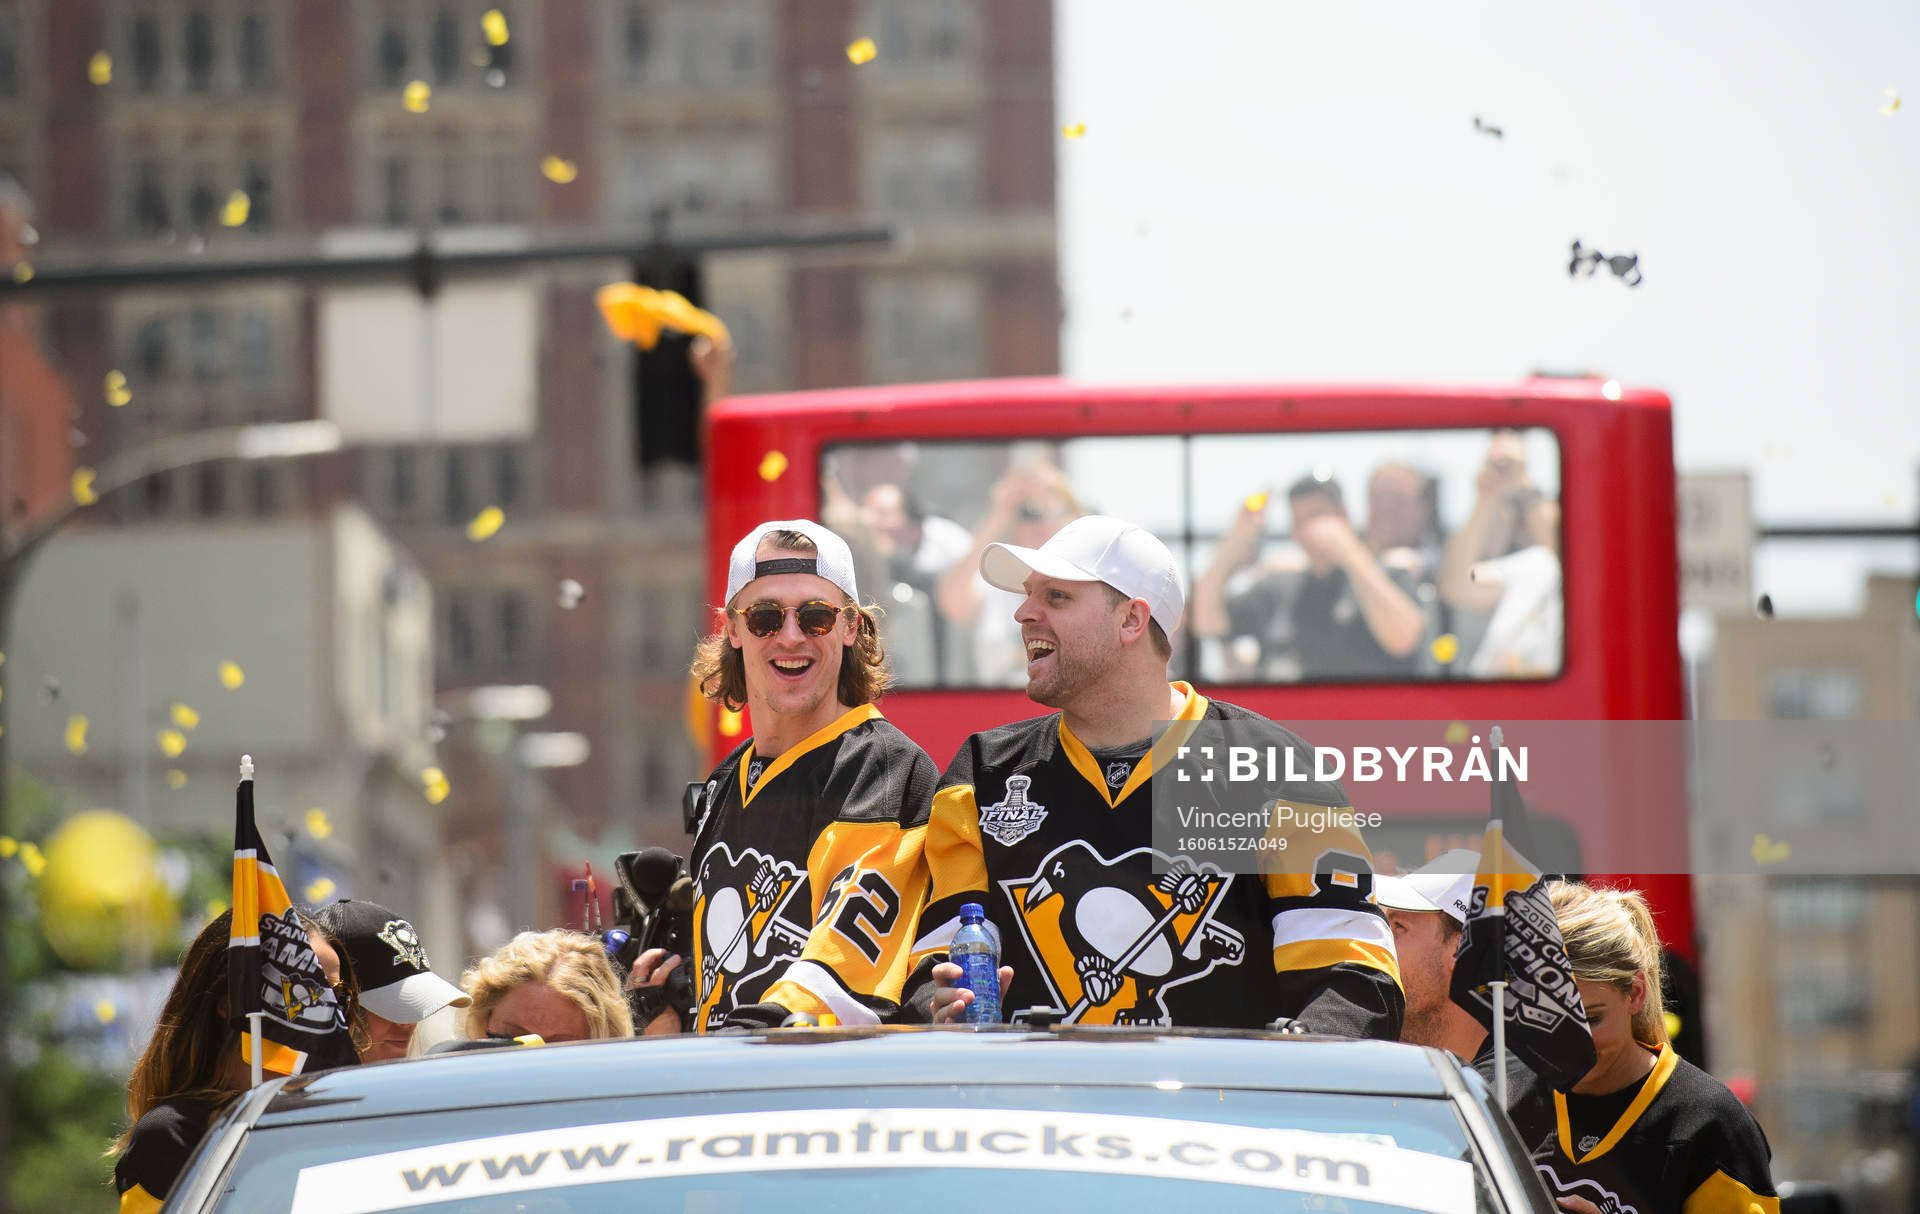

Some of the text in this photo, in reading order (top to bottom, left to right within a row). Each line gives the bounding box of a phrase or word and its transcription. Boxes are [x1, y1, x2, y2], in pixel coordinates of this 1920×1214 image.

[986, 810, 1041, 821] FINAL
[1520, 906, 1552, 935] 2016
[400, 1120, 1372, 1192] www.ramtrucks.com
